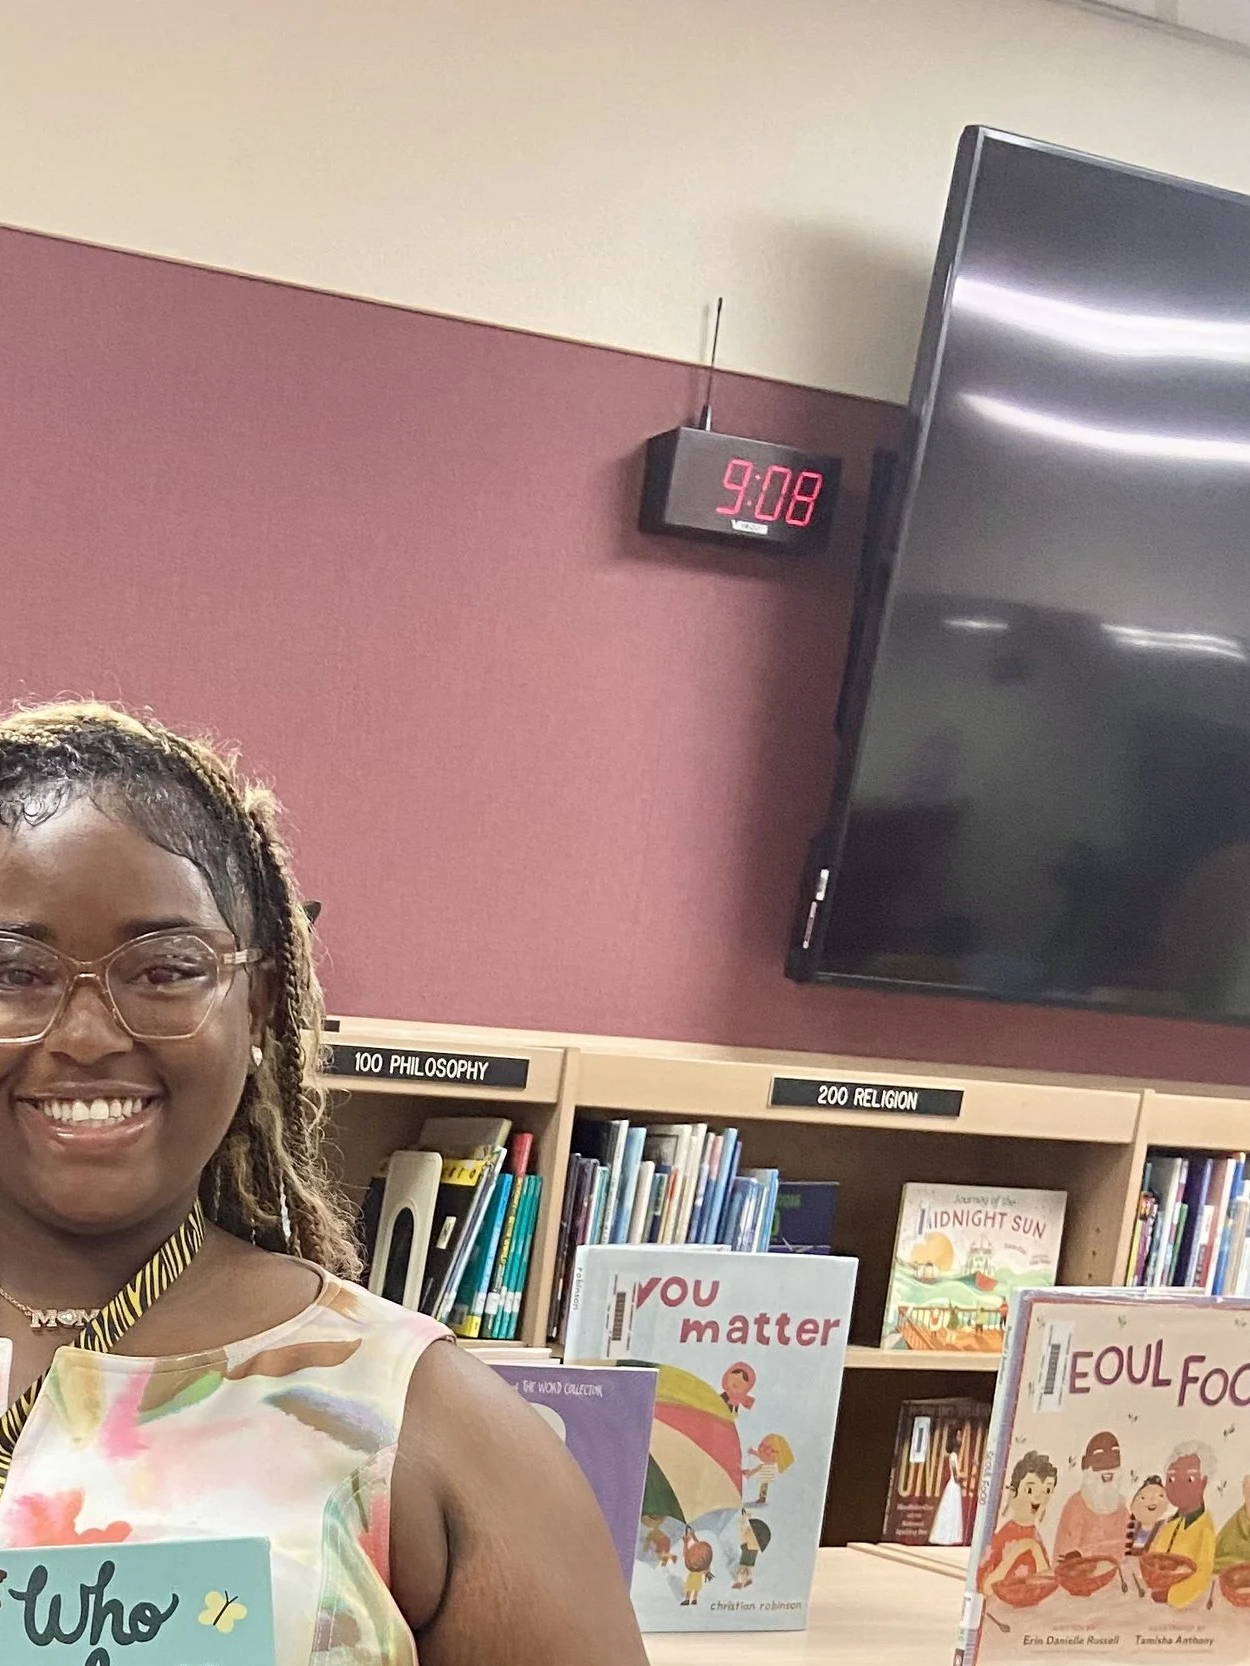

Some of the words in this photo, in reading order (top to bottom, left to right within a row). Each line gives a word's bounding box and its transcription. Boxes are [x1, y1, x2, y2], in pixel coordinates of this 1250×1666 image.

[716, 458, 823, 527] 9:08
[354, 1052, 383, 1073] 100
[390, 1054, 489, 1081] PHILOSOPHY
[817, 1085, 848, 1105] 200
[853, 1087, 919, 1110] RELIGION
[928, 1207, 1008, 1230] IDNIGHT
[1011, 1215, 1047, 1239] SUN
[573, 1267, 583, 1312] robinson
[679, 1311, 841, 1348] matter
[1069, 1338, 1172, 1394] EOUL
[523, 1380, 537, 1393] THE
[538, 1381, 562, 1395] WORD
[9, 1559, 179, 1648] Who
[710, 1600, 755, 1612] christian
[759, 1600, 803, 1611] robinson
[1023, 1635, 1044, 1646] Erin
[1046, 1635, 1084, 1645] Danielle
[1086, 1635, 1119, 1645] Russell
[1135, 1635, 1172, 1645] Tamisha
[1174, 1635, 1214, 1647] Anthony
